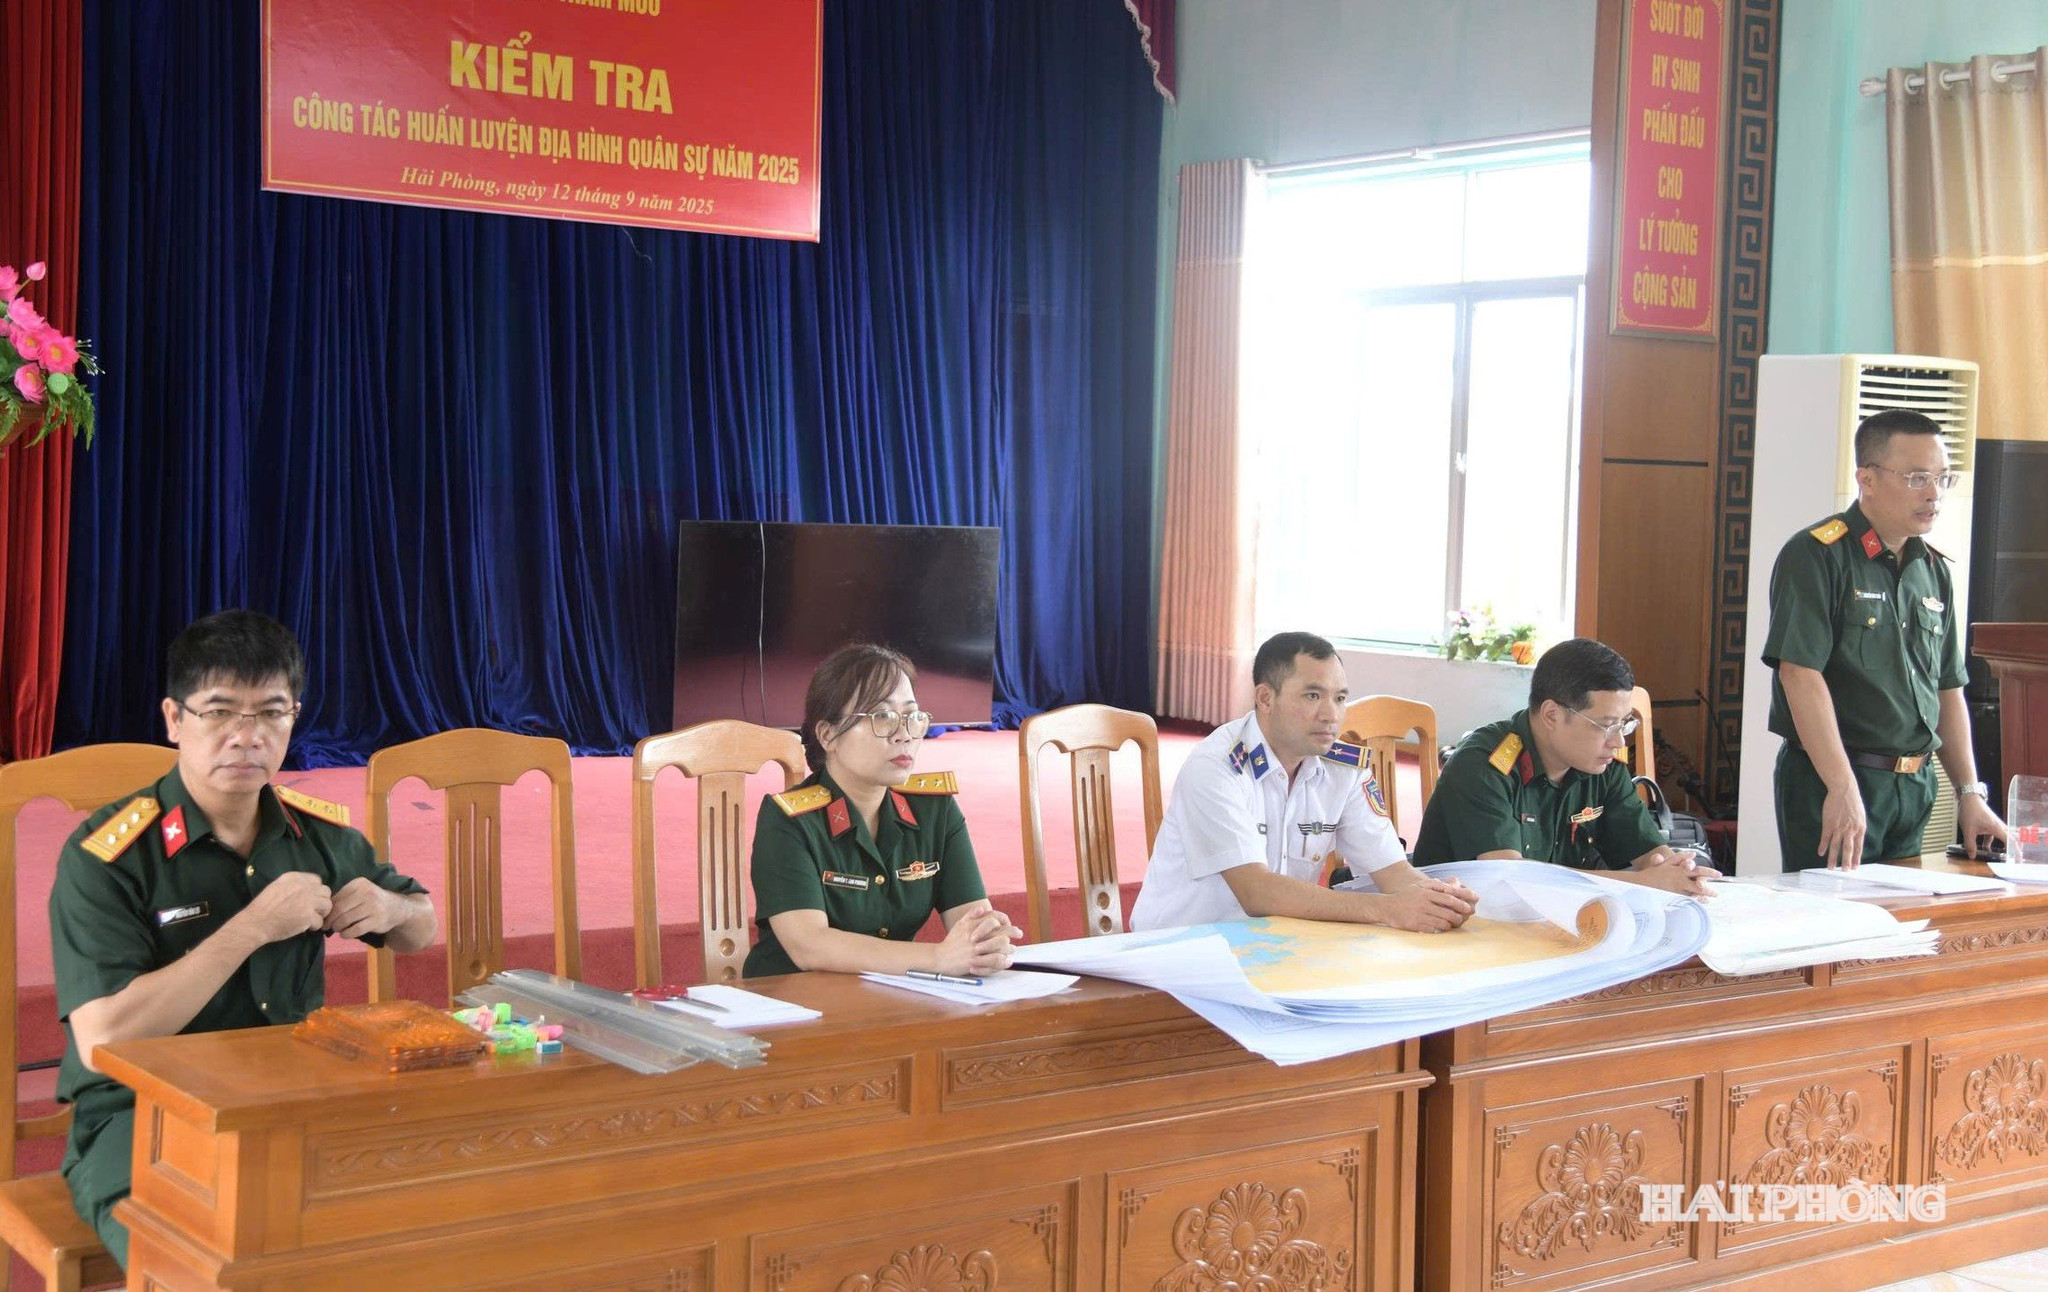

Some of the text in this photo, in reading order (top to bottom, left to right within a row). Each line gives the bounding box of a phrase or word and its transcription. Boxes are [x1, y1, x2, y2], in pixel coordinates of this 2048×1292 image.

[451, 31, 674, 114] KIỂM TRA
[1652, 54, 1700, 94] HY SINH
[293, 92, 799, 185] CÔNG TÁC HUẤN LUYỆN ĐỊA HÌNH QUÂN SỰ NĂM 2025
[1643, 101, 1704, 149] PHẤN ĐẤU
[401, 166, 715, 215] Hải Phòng, ngày 12 tháng 9 năm 2025
[1658, 166, 1683, 201] CHO
[1639, 207, 1698, 256] LÝ TƯỞNG
[1633, 264, 1697, 312] CỘNG SẢN
